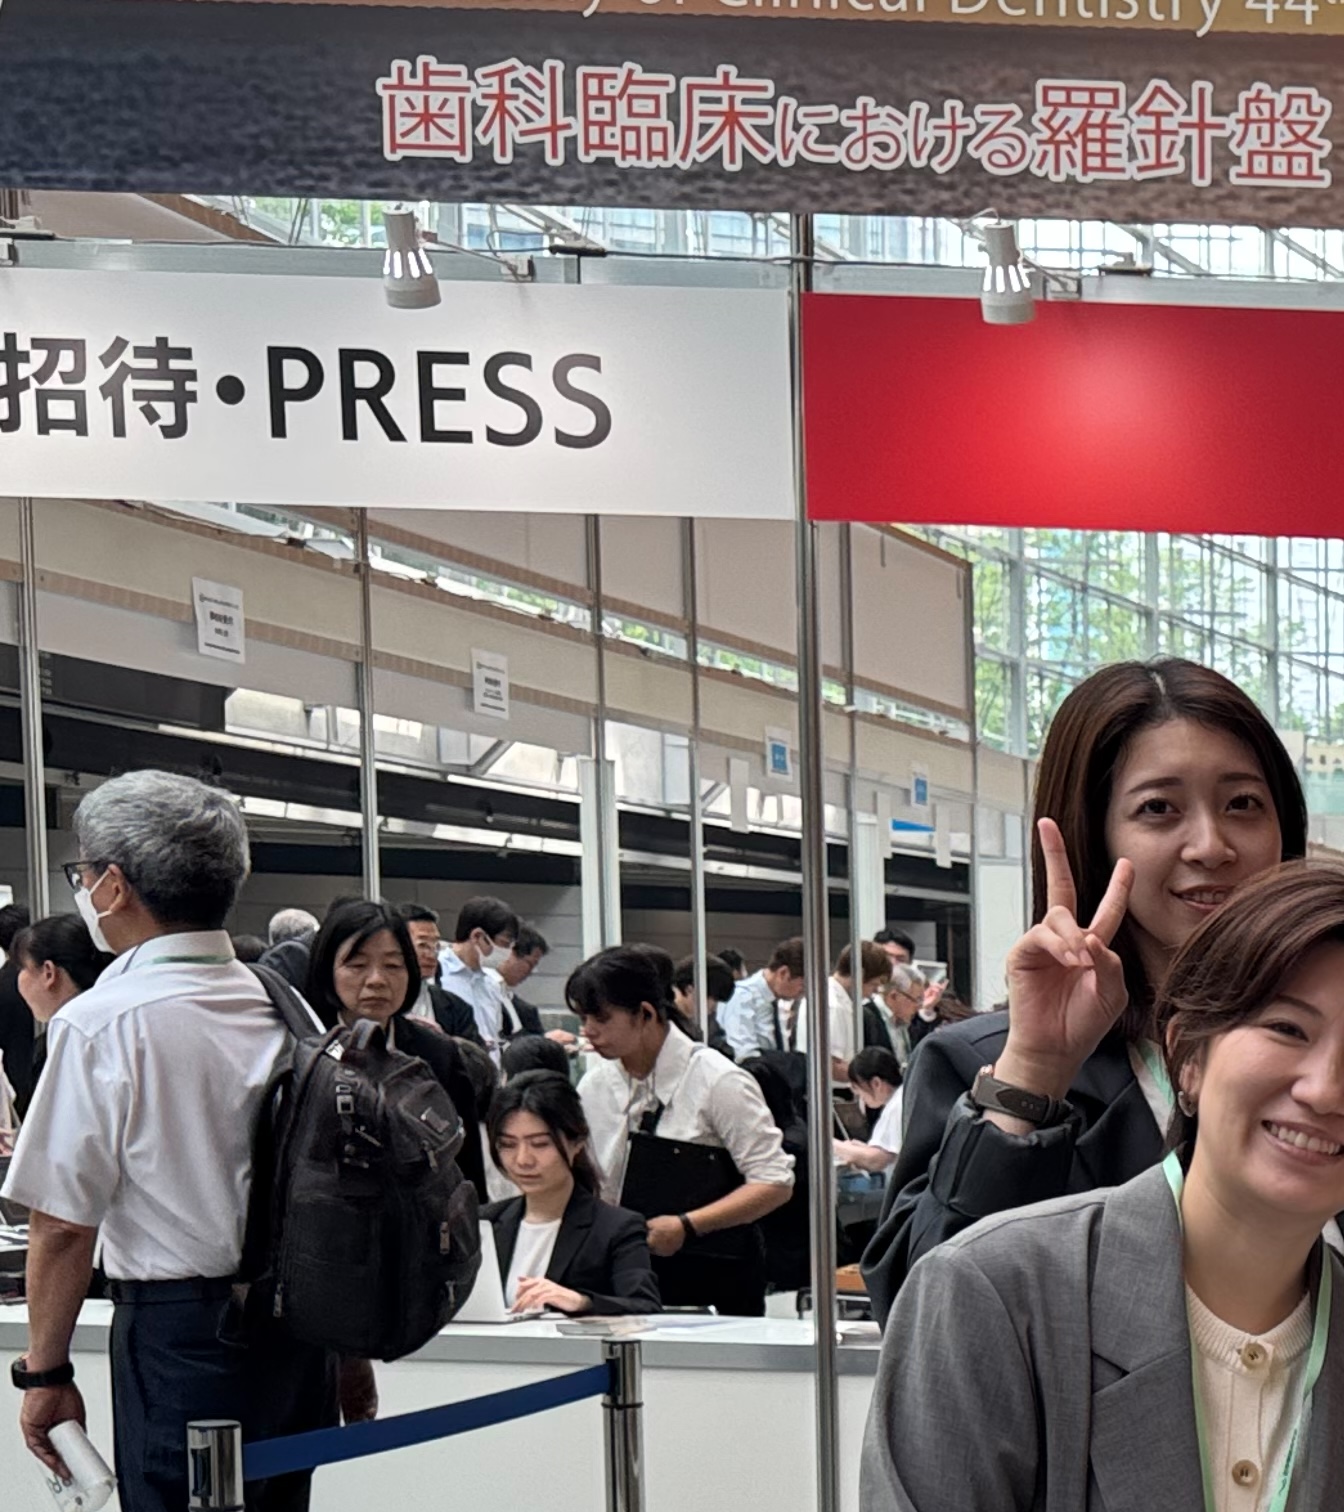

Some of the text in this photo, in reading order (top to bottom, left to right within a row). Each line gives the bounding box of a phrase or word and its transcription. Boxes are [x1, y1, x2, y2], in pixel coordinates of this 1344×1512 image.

[376, 55, 1331, 187] 歯科臨床における羅針盤
